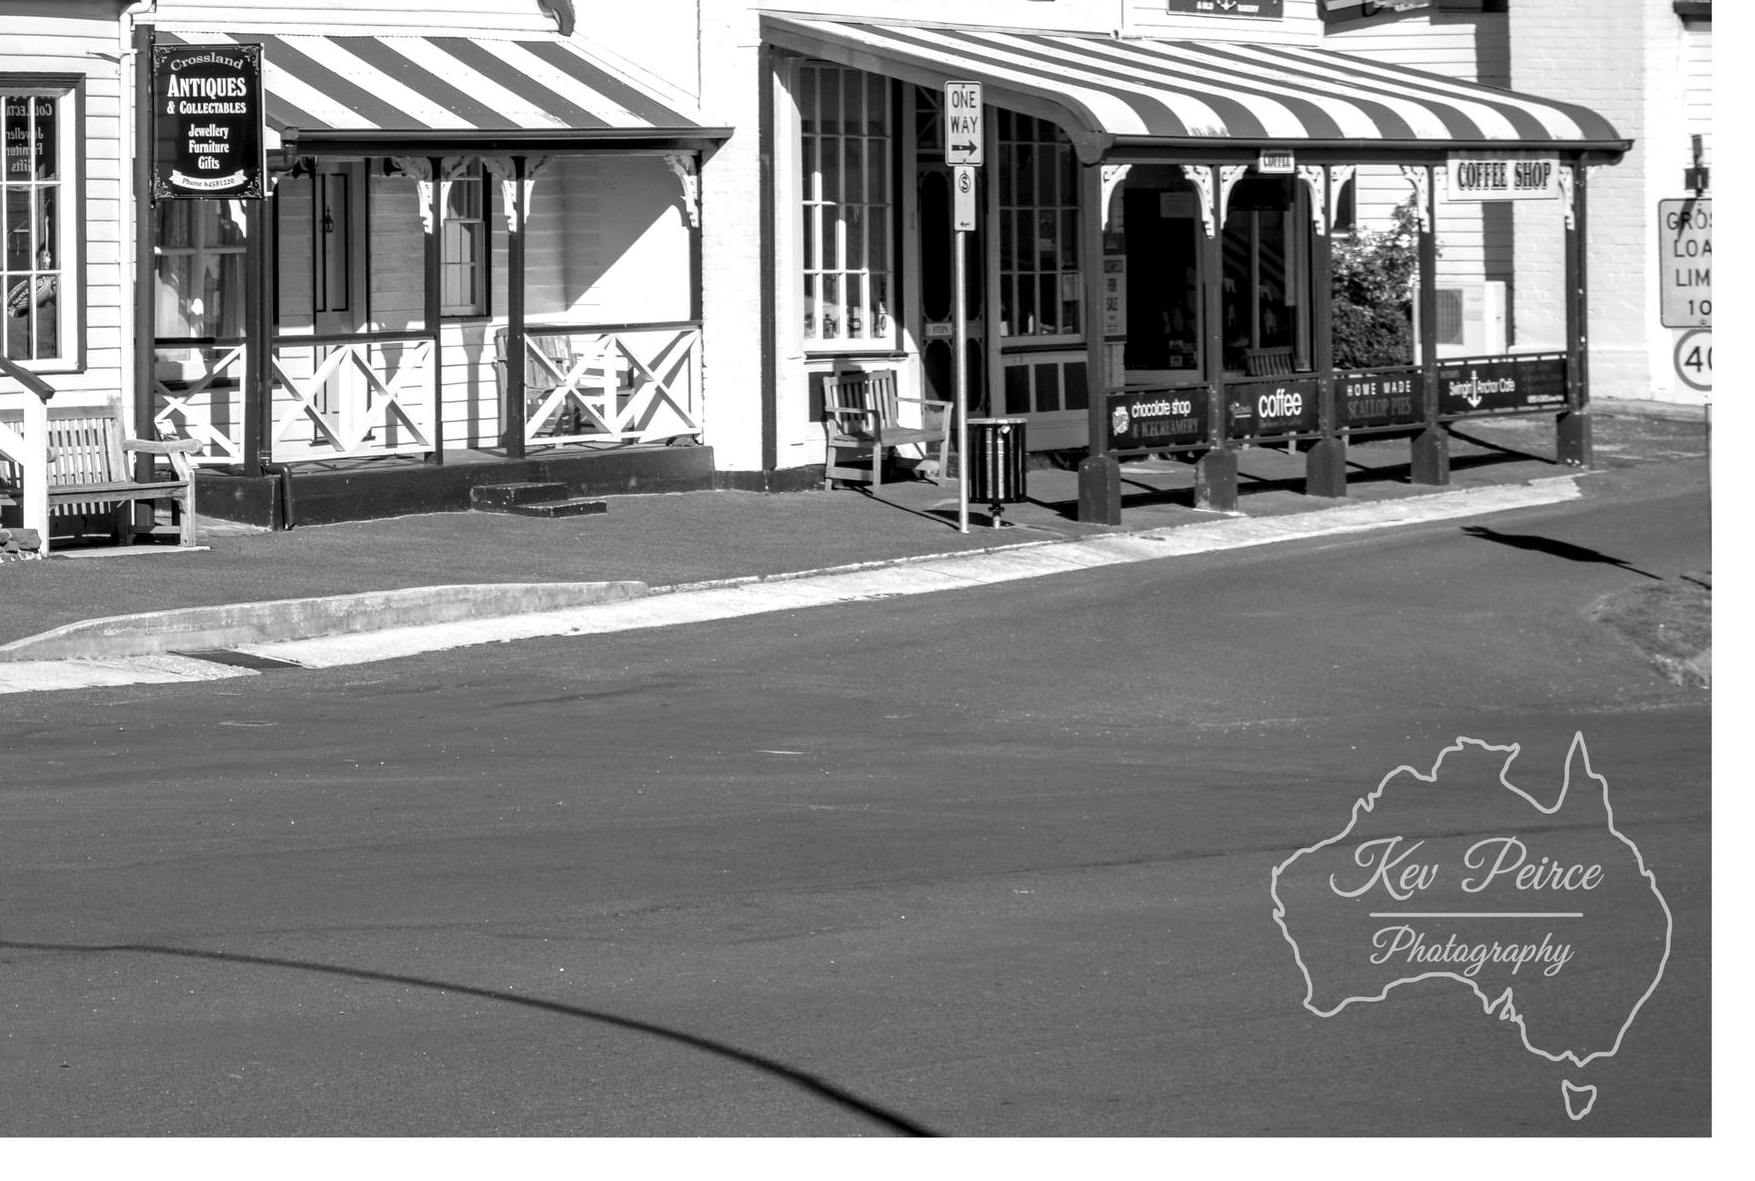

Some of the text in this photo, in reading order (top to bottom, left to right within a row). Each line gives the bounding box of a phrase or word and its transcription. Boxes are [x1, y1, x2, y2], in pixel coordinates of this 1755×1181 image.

[170, 52, 244, 71] Crossland
[167, 74, 247, 99] ANTIQUES
[167, 100, 247, 114] & COLLECTABLES
[952, 90, 977, 109] ONE
[188, 124, 229, 139] Jewellery
[950, 116, 978, 134] WAY
[188, 140, 230, 153] Furniture
[198, 156, 220, 169] Gifts
[182, 177, 203, 187] Phone
[1458, 161, 1552, 191] COFFEE SHOP
[1346, 380, 1412, 397] HOME MADE
[1131, 398, 1191, 418] chocolate shop
[1257, 388, 1303, 418] coffee
[1348, 397, 1413, 420] SCALLOP PIES
